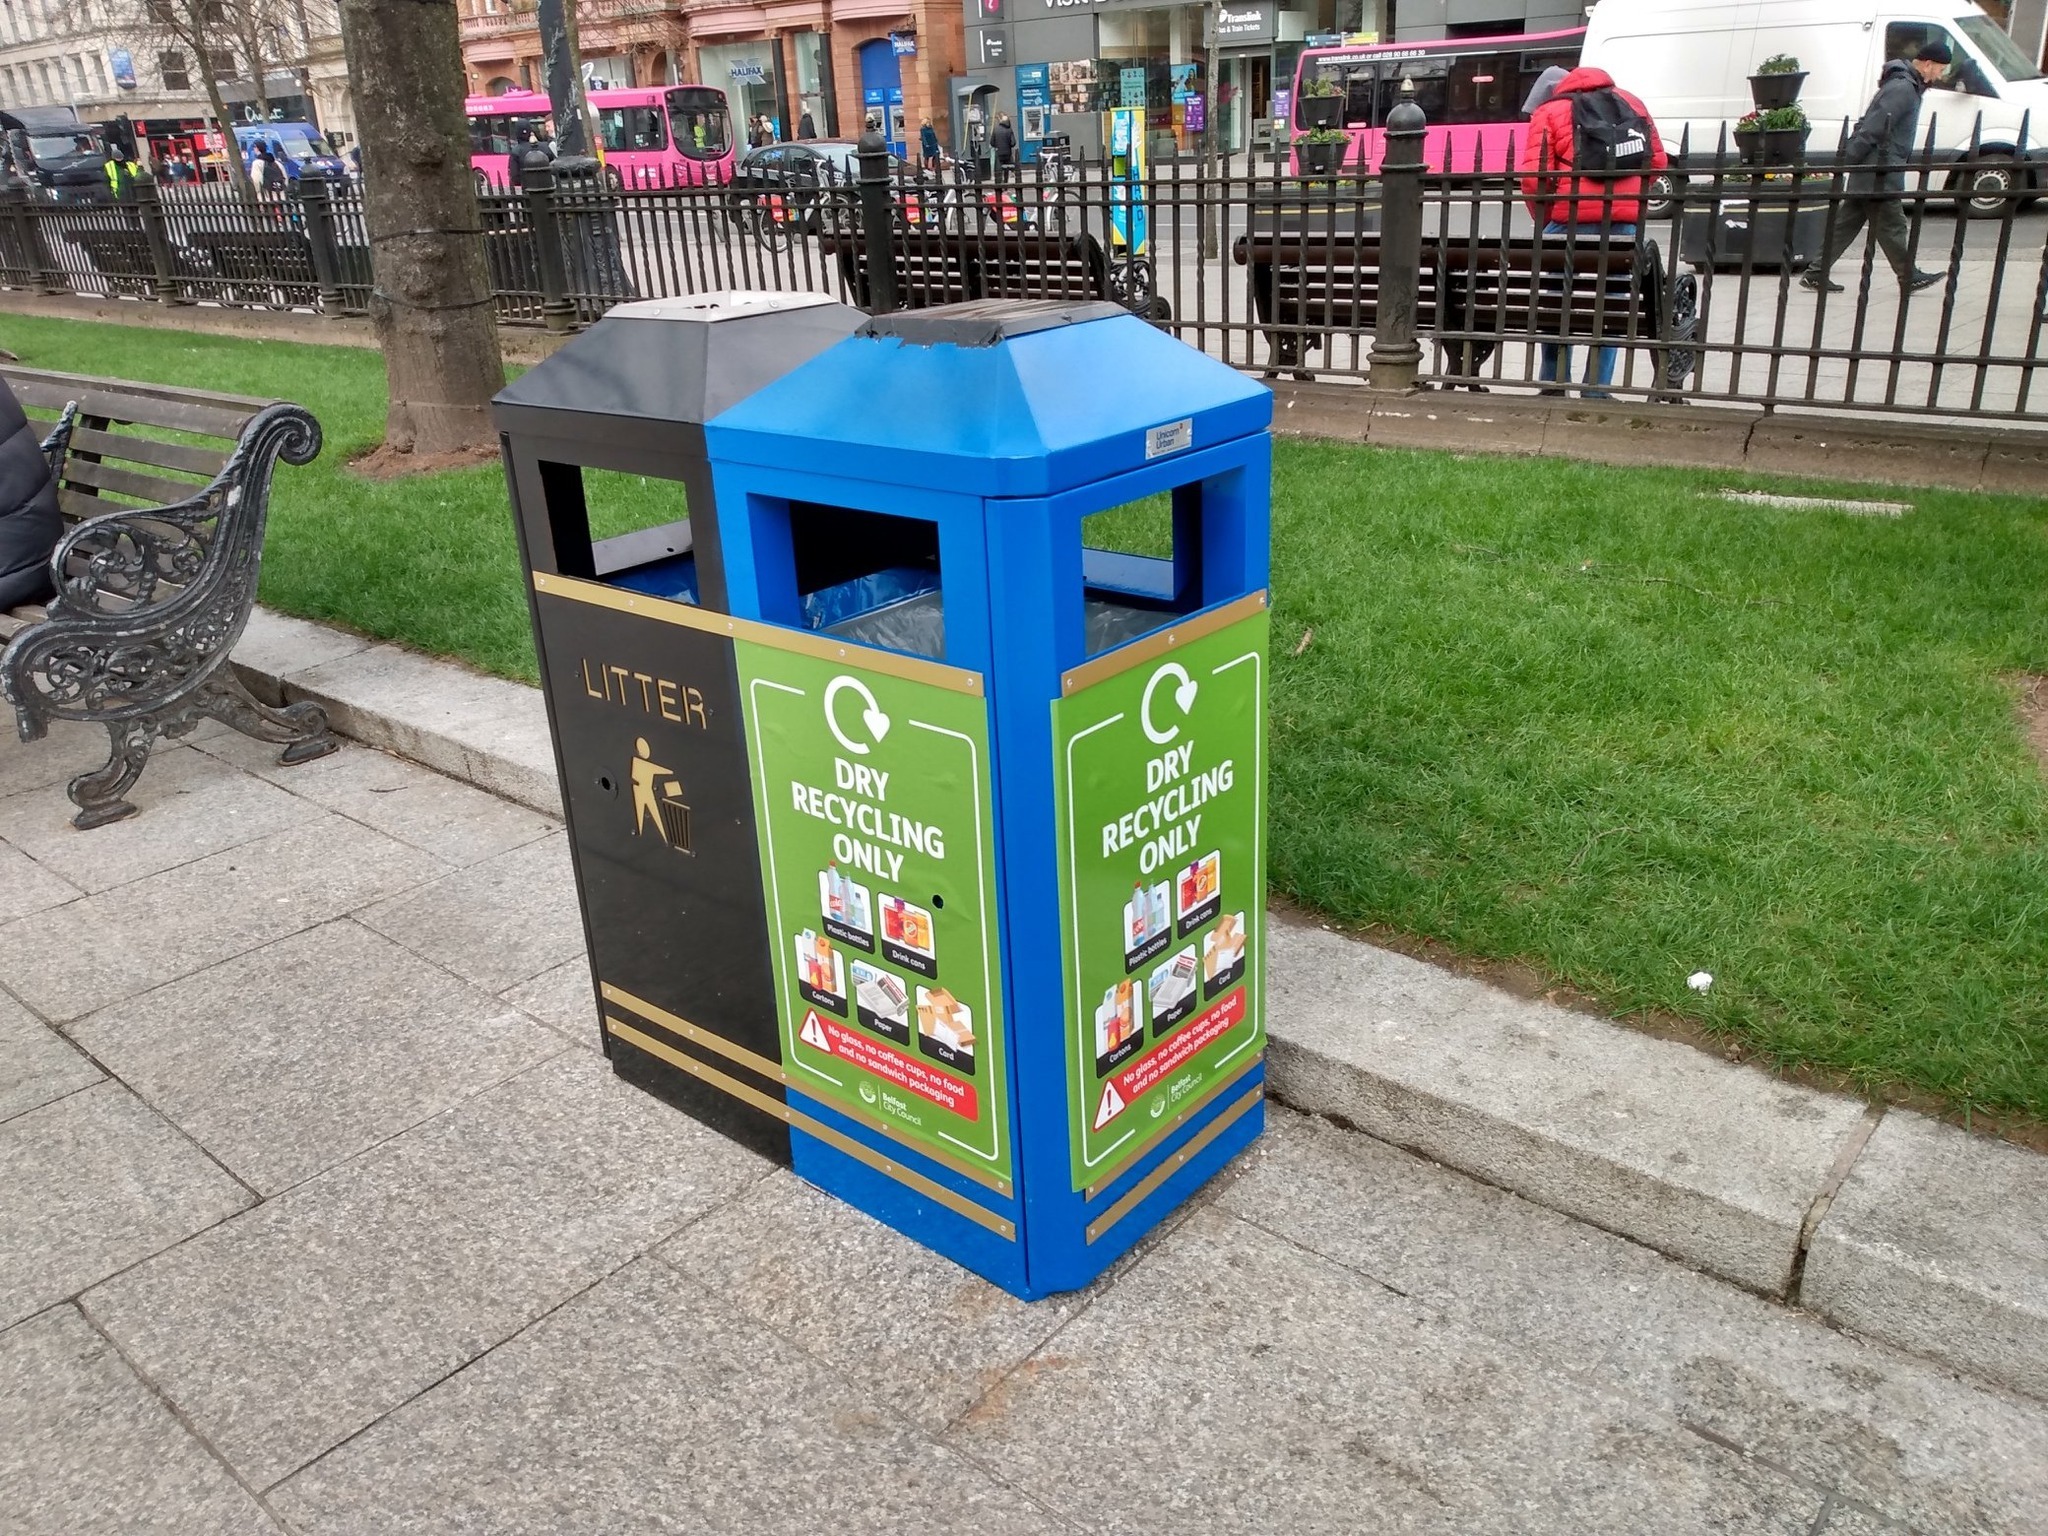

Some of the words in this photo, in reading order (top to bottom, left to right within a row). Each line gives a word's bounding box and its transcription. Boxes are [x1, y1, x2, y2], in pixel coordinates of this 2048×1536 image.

[1227, 11, 1262, 23] Translink
[731, 66, 763, 77] HALIFAX
[1156, 428, 1180, 440] Unicorn
[1156, 438, 1175, 449] Urban
[582, 658, 707, 730] LITTER
[1146, 740, 1194, 793] DRY
[834, 757, 889, 801] DRY
[791, 780, 945, 859] RECYCLING
[1102, 760, 1233, 858] RECYCLING
[1139, 814, 1201, 874] ONLY
[833, 833, 904, 883] ONLY
[1185, 914, 1200, 929] Drink
[1199, 908, 1213, 920] cans
[827, 924, 847, 939] Plastic
[847, 931, 869, 947] bottles
[892, 950, 910, 964] Drink
[910, 957, 926, 971] cans
[1128, 948, 1148, 967] Plastic
[1147, 937, 1167, 954] bottles
[1218, 971, 1231, 985] Card
[812, 991, 835, 1006] Cartons
[874, 1018, 892, 1033] Paper
[1167, 1007, 1183, 1021] Paper
[1123, 1073, 1135, 1086] No
[1135, 1058, 1157, 1081] glass,
[1157, 1048, 1168, 1060] no
[1168, 1029, 1192, 1053] coffee
[1192, 1018, 1210, 1036] cups,
[1210, 1009, 1221, 1021] no
[1221, 995, 1237, 1013] food
[828, 1025, 840, 1039] No
[841, 1030, 864, 1051] glass,
[865, 1043, 877, 1055] no
[878, 1048, 905, 1069] coffee
[906, 1062, 929, 1082] cups,
[929, 1073, 942, 1086] no
[943, 1078, 965, 1097] food
[938, 1047, 955, 1061] Card
[1109, 1043, 1131, 1063] Cartons
[1132, 1077, 1148, 1094] and
[1148, 1069, 1159, 1081] no
[1159, 1042, 1194, 1072] sandwich
[1193, 1017, 1230, 1051] packaging
[838, 1045, 855, 1059] and
[855, 1053, 867, 1065] no
[868, 1056, 908, 1083] sandwich
[909, 1076, 955, 1108] packaging
[1171, 1074, 1192, 1094] Belfast
[1171, 1089, 1182, 1103] City
[1182, 1072, 1202, 1091] Council
[882, 1092, 908, 1111] Belfast
[883, 1102, 896, 1115] City
[896, 1108, 922, 1126] Council
